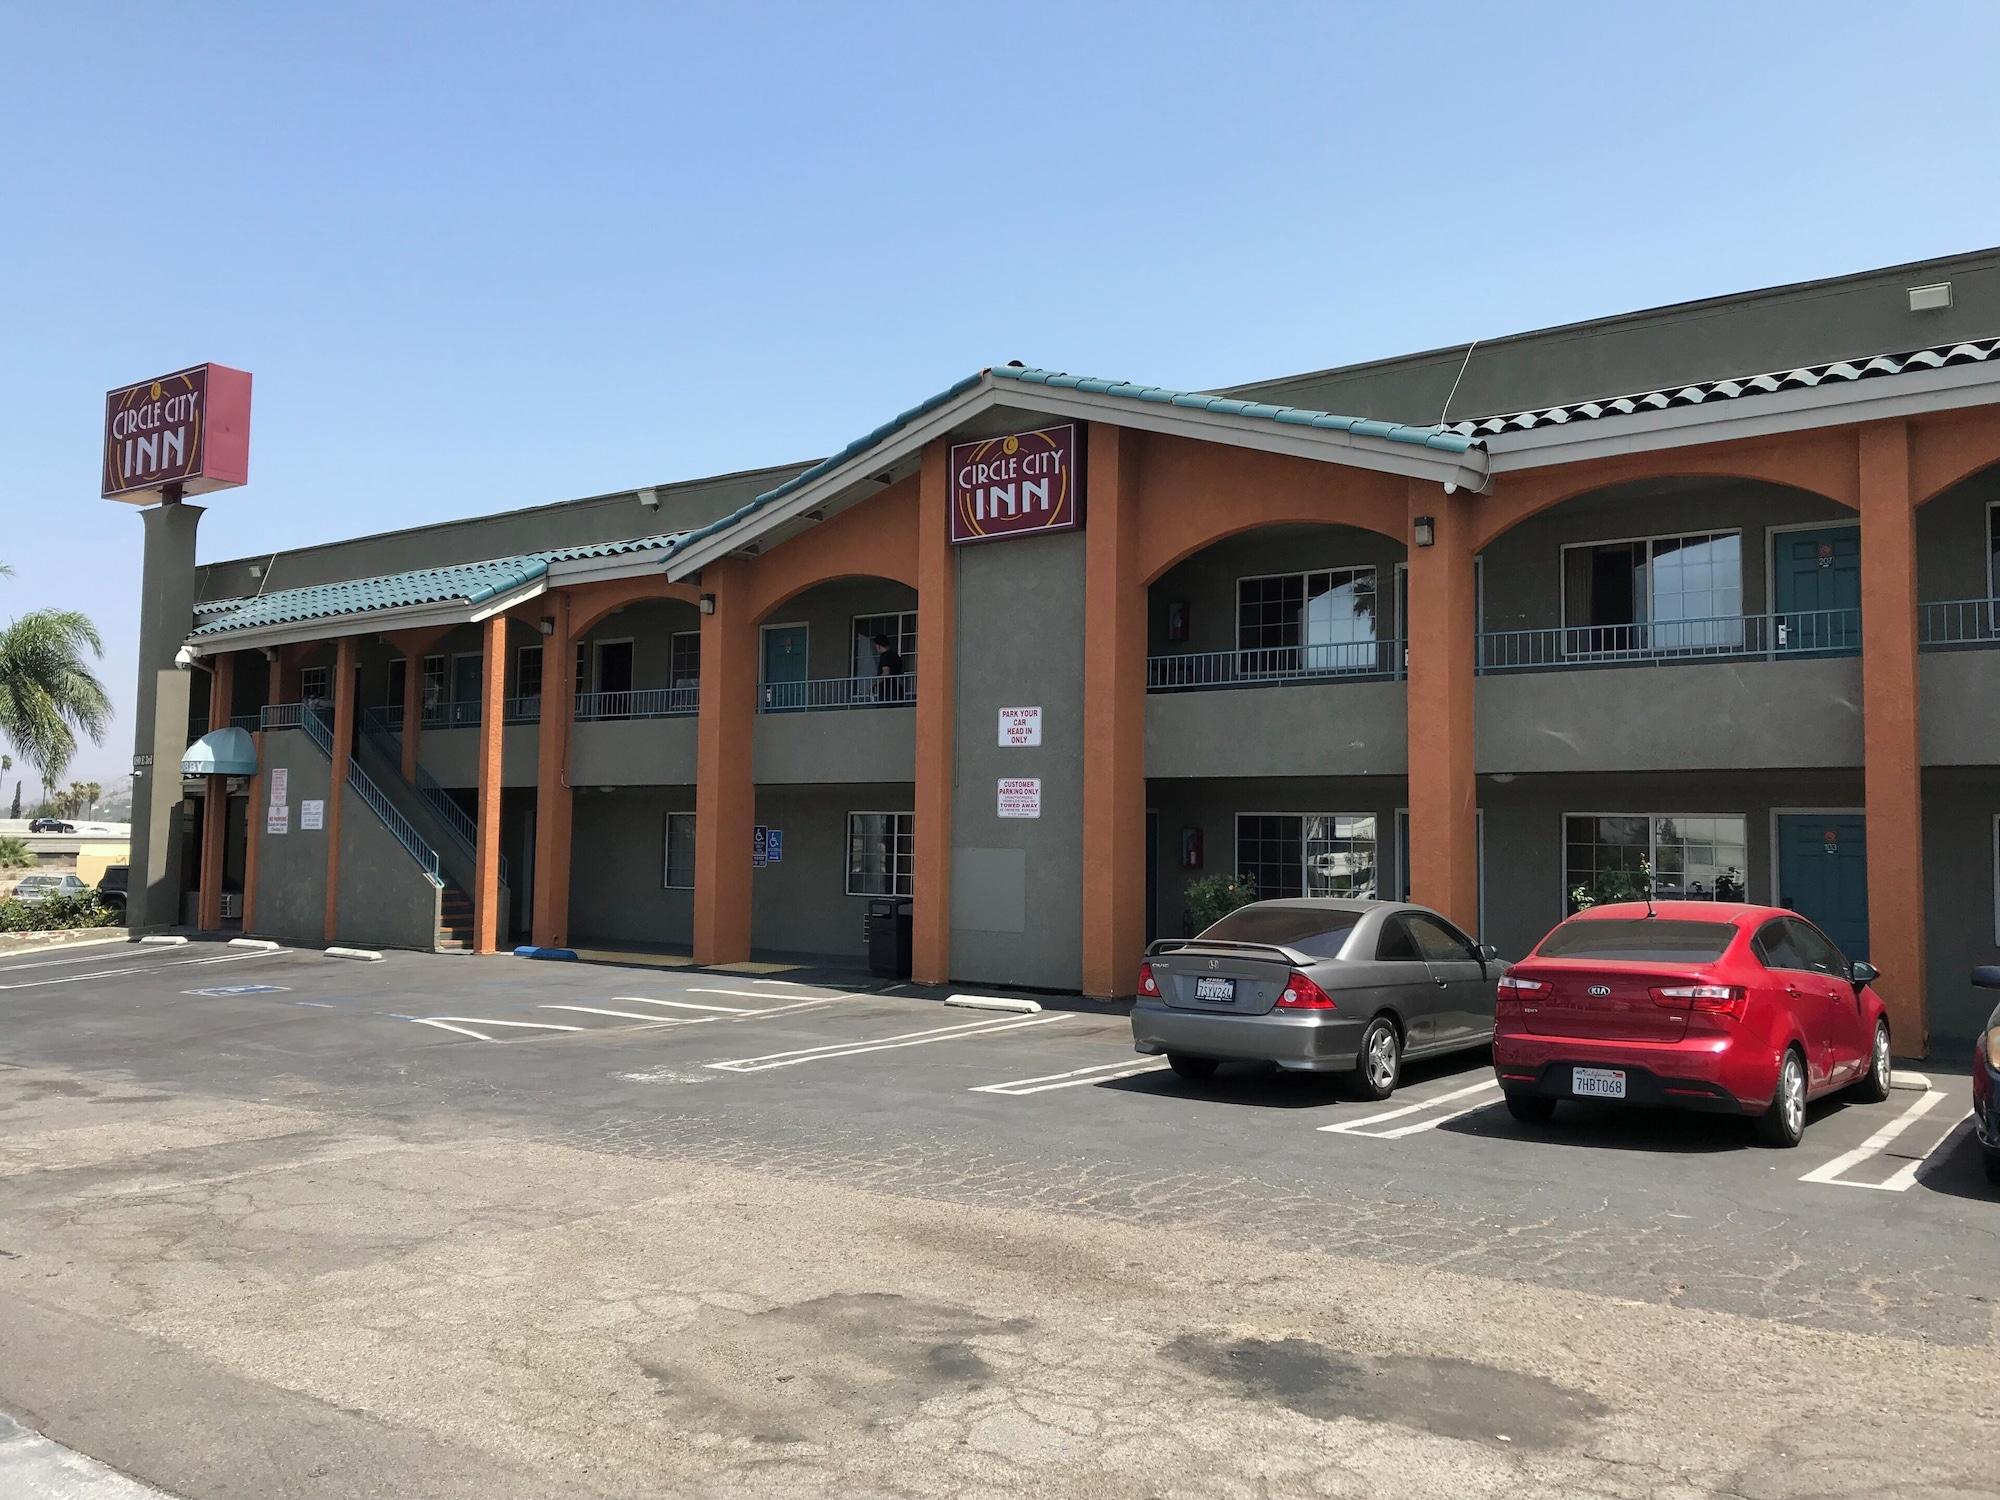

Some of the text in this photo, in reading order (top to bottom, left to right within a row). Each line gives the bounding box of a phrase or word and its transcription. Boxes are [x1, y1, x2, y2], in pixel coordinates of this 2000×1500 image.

[112, 391, 198, 440] CIRCLE CITY
[124, 426, 185, 478] INN
[958, 449, 1064, 489] CIRCLE CITY
[975, 477, 1049, 521] INN
[1818, 556, 1833, 565] 207
[1002, 710, 1019, 718] PARK
[1007, 727, 1032, 735] HEAD IN
[1011, 736, 1028, 744] ONLY
[184, 761, 204, 772] BBY
[1591, 987, 1607, 995] KIA
[1576, 1077, 1622, 1094] 7HBT068
